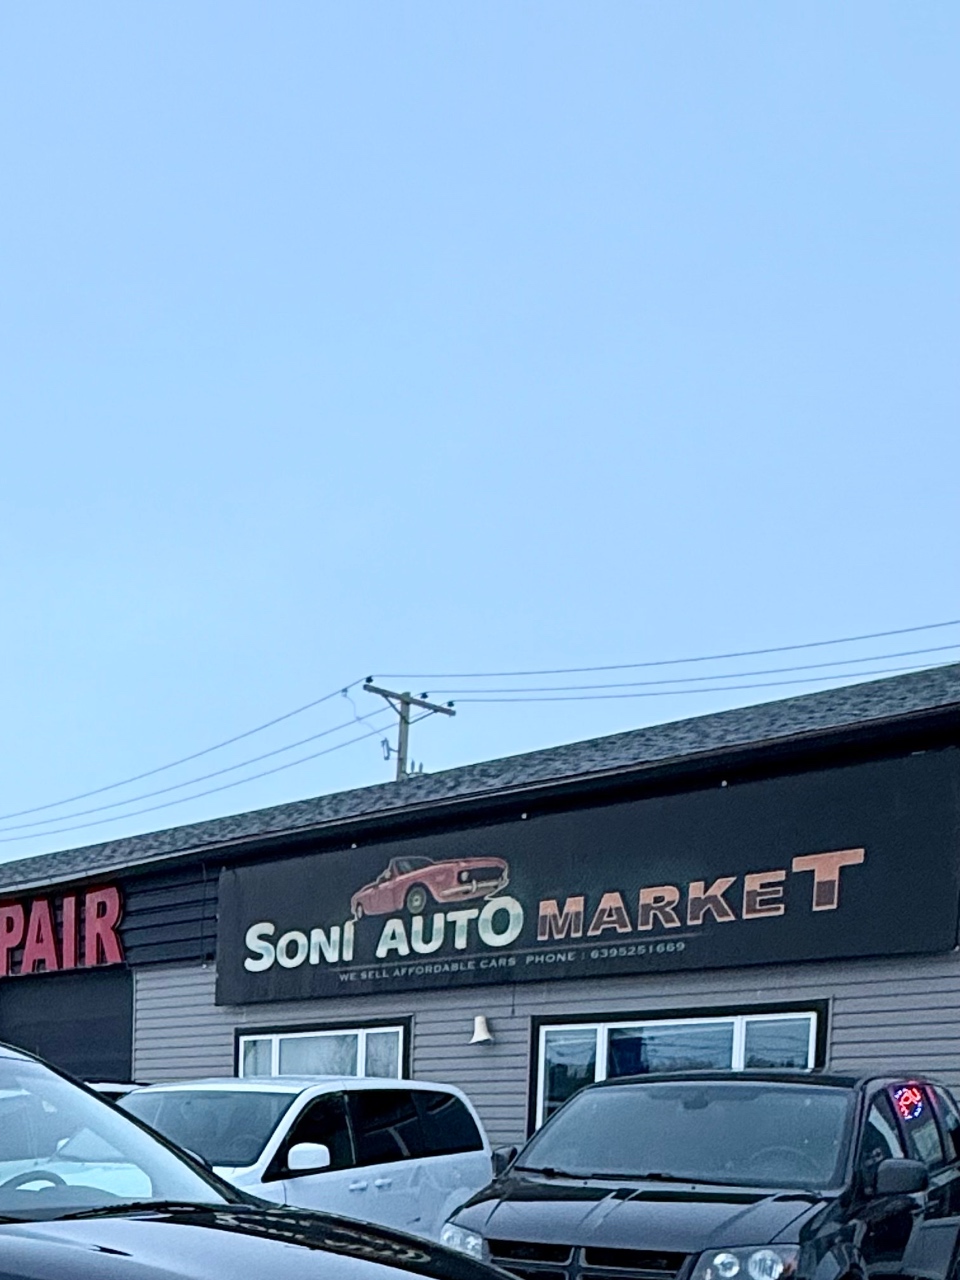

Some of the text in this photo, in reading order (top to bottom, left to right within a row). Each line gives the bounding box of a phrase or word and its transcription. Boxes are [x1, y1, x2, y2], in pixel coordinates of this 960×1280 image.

[375, 896, 524, 958] AUTO
[537, 848, 865, 942] MARKET
[339, 972, 357, 982] WE
[360, 969, 390, 980] SELL
[392, 960, 476, 977] AFFORDABLE
[479, 957, 516, 969] CARS
[525, 952, 576, 965] PHONE
